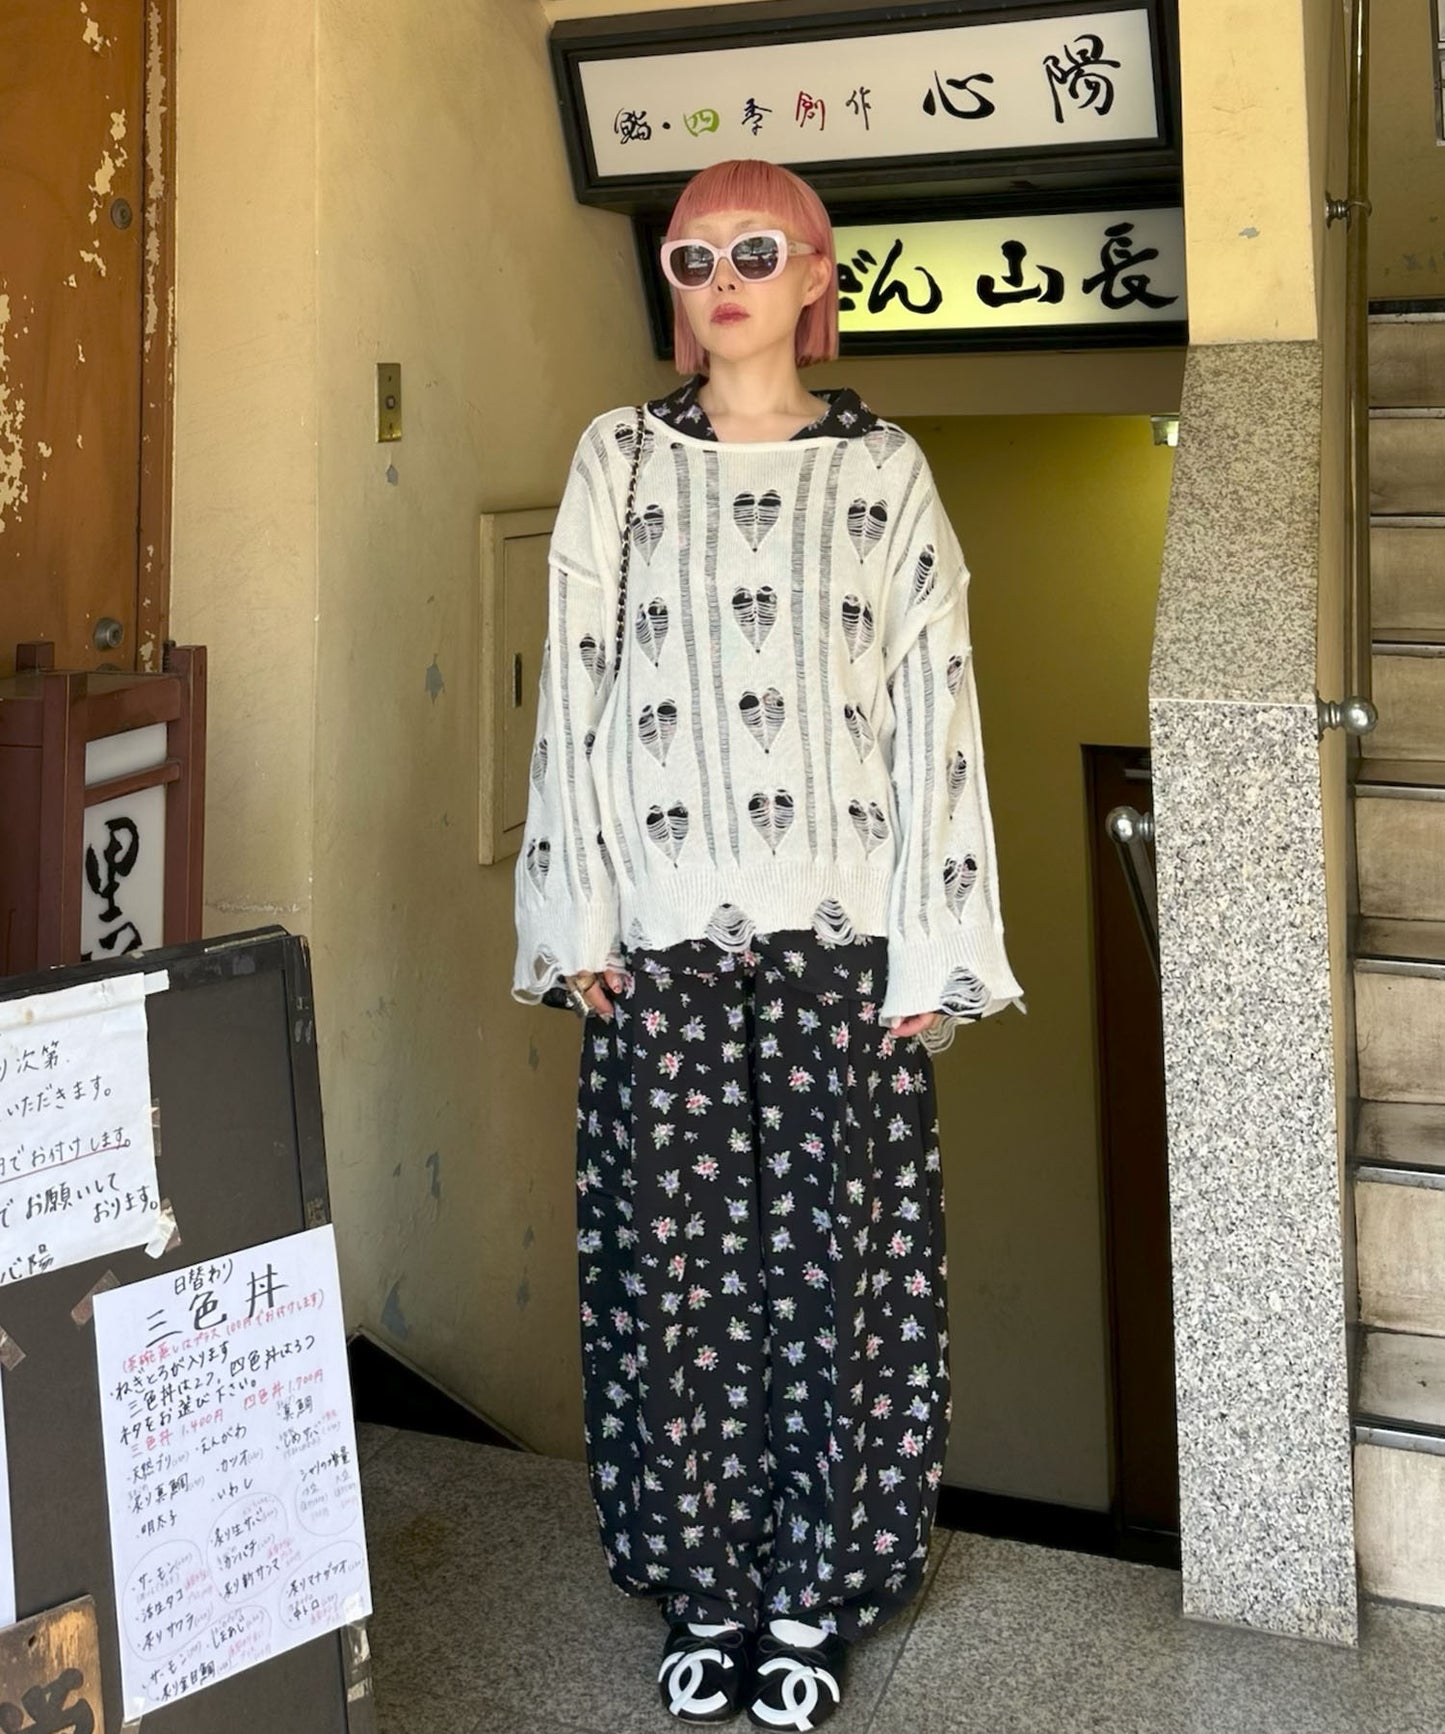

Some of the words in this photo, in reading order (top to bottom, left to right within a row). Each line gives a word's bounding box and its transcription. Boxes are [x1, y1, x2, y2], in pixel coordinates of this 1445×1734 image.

[922, 33, 1122, 124] 心陽
[145, 1263, 290, 1348] 三色丼
[174, 1258, 234, 1295] 日替わり
